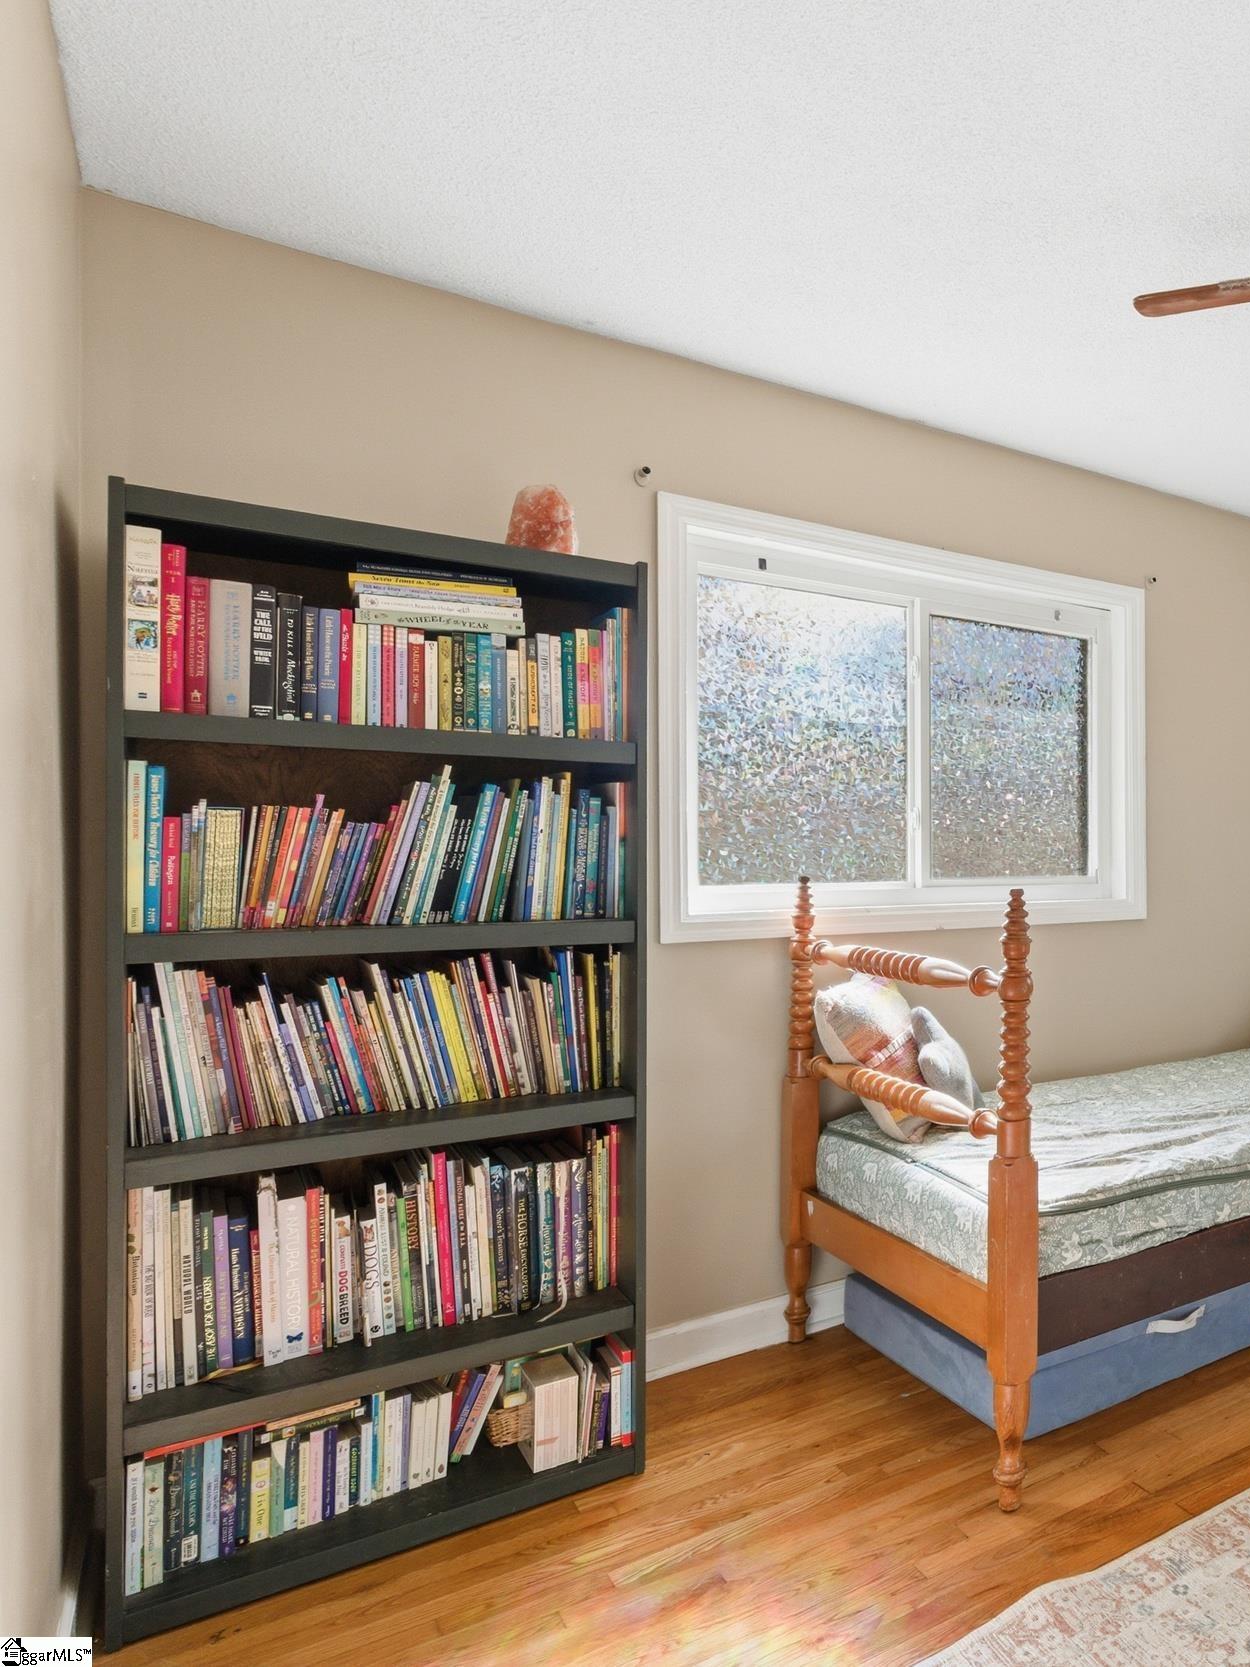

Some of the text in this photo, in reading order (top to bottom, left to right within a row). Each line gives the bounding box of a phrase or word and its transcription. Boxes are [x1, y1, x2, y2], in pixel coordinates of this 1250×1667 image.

[166, 594, 182, 636] Harry Potter
[254, 618, 272, 627] CALL
[256, 611, 271, 620] THE
[405, 616, 446, 624] WHEEL
[461, 621, 489, 630] YEAR
[196, 601, 206, 677] HARRY POTTER
[254, 632, 273, 641] WILD
[282, 659, 296, 703] Mockingbird
[456, 1176, 464, 1201] NATIONAL
[406, 1200, 419, 1250] HISTORY
[496, 1208, 504, 1233] Nature's
[518, 1212, 528, 1248] HORSE
[132, 1255, 140, 1296] Botanicum
[183, 1254, 193, 1314] NATURAL WORLD
[286, 1217, 301, 1330] NATURAL HISTORY
[339, 1270, 348, 1292] DOG
[364, 1245, 380, 1290] DOGS
[520, 1248, 528, 1300] ENCYCLOPEDIA
[203, 1276, 213, 1310] CHILDREN
[231, 1248, 245, 1339] Hans Christian ANDERSEN
[339, 1293, 349, 1325] BREED
[204, 1310, 214, 1326] FOR
